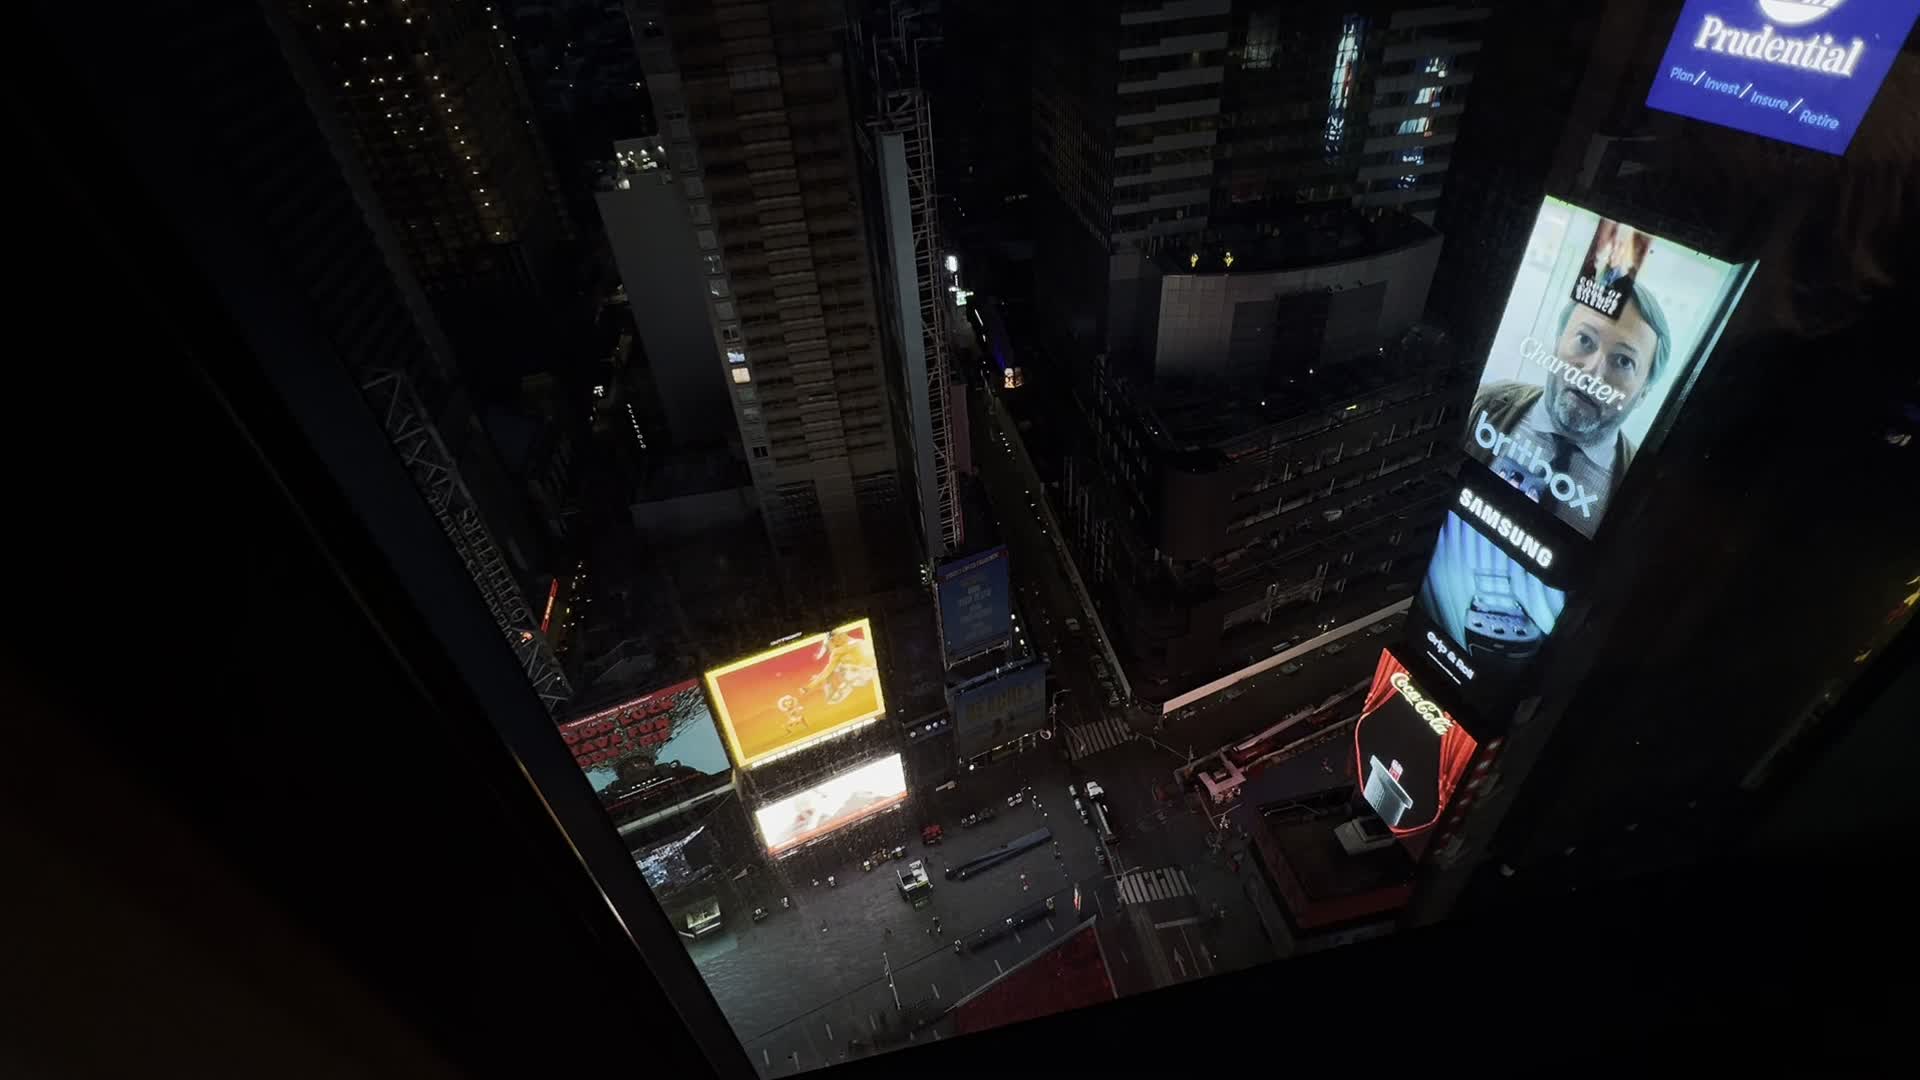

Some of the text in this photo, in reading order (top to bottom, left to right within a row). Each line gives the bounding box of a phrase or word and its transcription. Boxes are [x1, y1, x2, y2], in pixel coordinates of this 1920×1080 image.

[1694, 14, 1865, 77] Prudential
[1670, 67, 1694, 82] Plan
[1704, 76, 1740, 96] Invest
[1750, 91, 1788, 111] Insure
[1800, 109, 1840, 130] Retire
[1519, 336, 1626, 411] Character.
[1474, 410, 1599, 518] britbox
[1459, 487, 1554, 568] SAMSUNG
[1390, 671, 1455, 736] Coca-Cola
